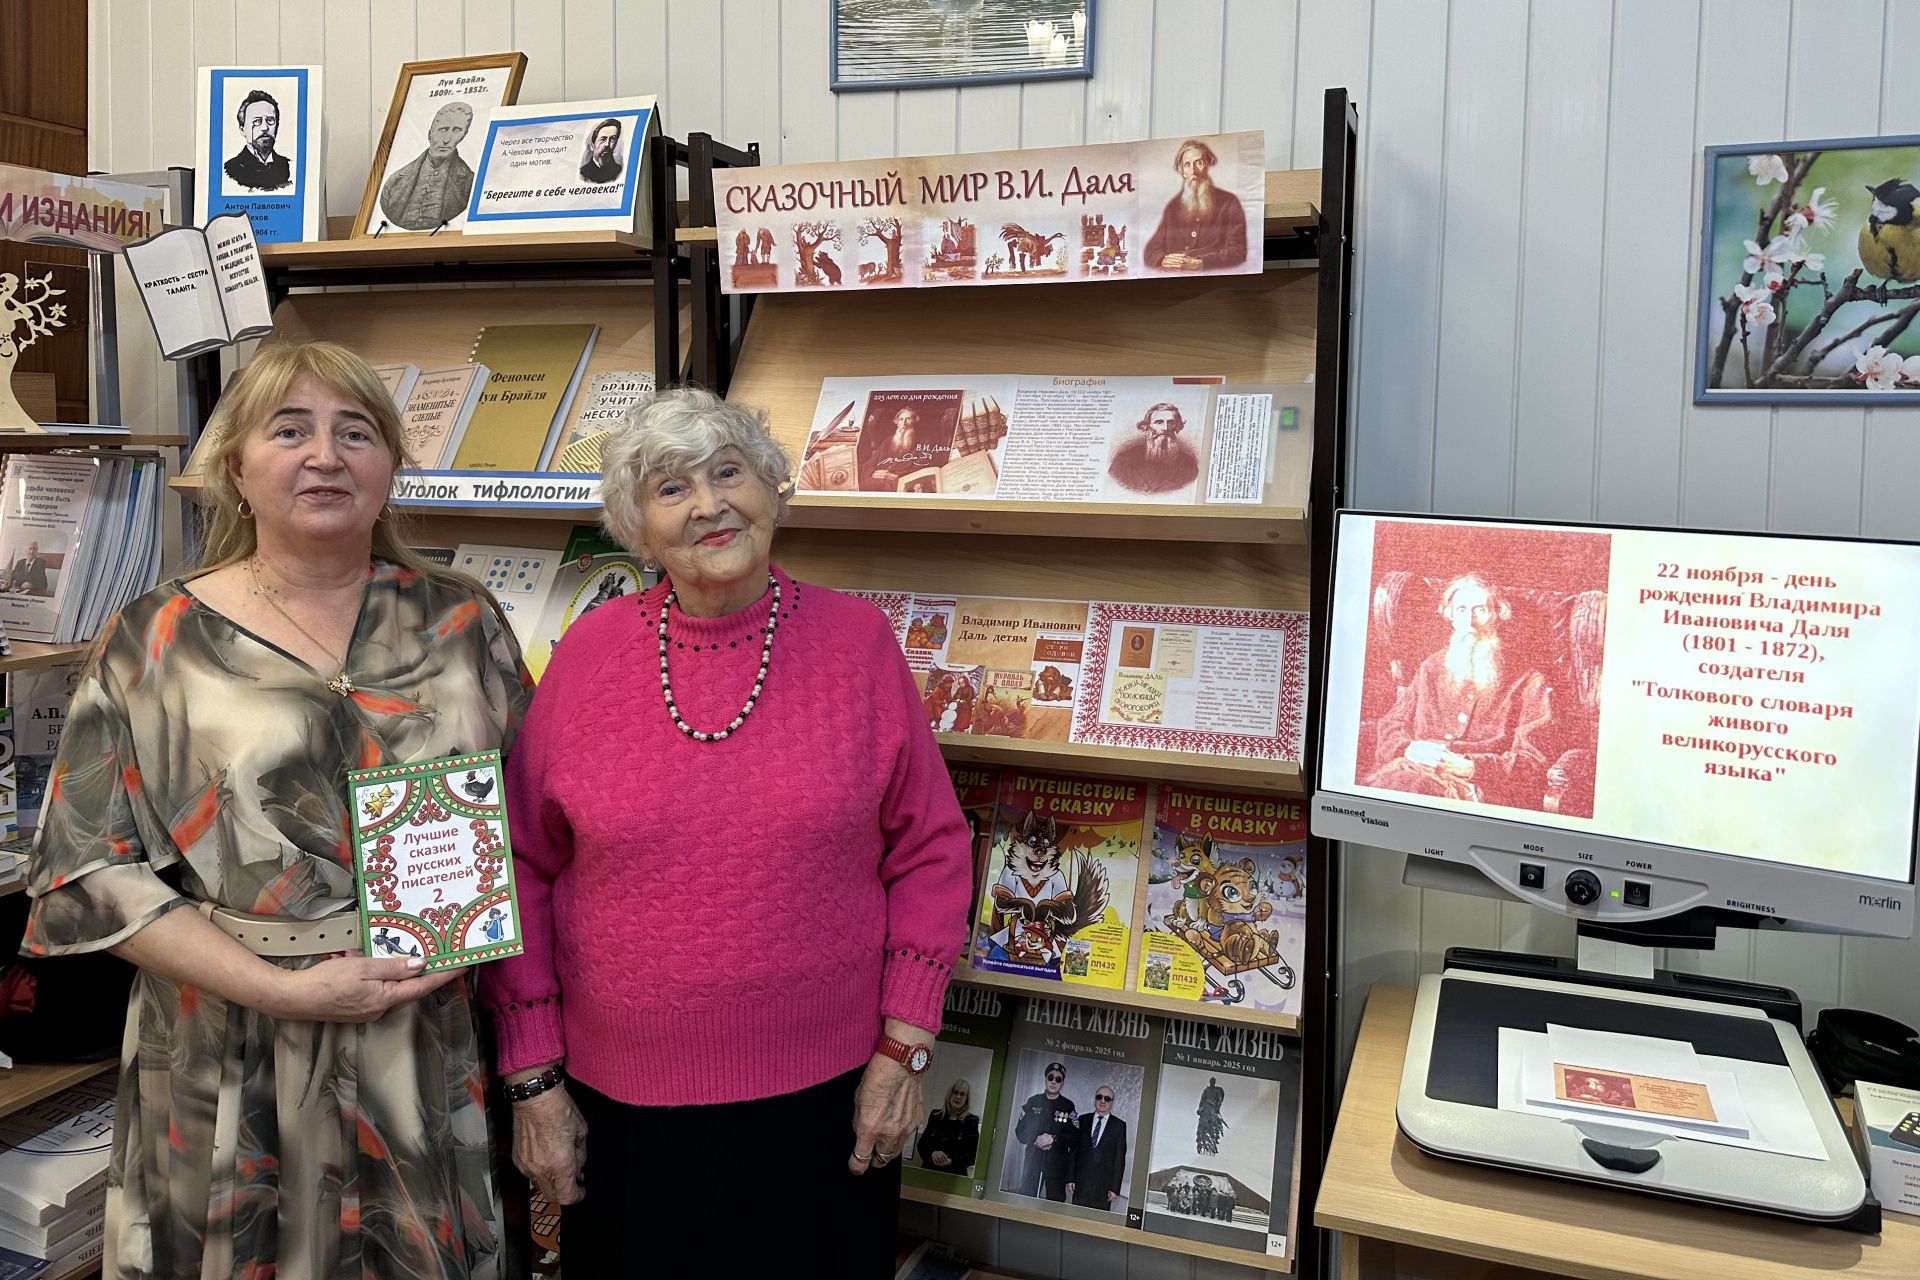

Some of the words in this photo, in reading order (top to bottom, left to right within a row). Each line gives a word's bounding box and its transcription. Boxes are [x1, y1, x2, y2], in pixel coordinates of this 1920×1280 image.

[438, 78, 453, 87] Луи
[455, 75, 486, 85] Брайль
[429, 88, 454, 98] 1809г.
[463, 86, 488, 95] 1852г.
[500, 137, 520, 147] Через
[521, 137, 533, 145] все
[534, 134, 573, 144] творчество
[533, 146, 567, 156] проходит
[509, 160, 527, 168] один
[483, 189, 534, 201] "Берегите
[543, 186, 565, 197] себе
[568, 183, 625, 196] человека!"
[725, 170, 907, 214] СКАЗОЧНЫЙ
[919, 171, 988, 205] МИР
[994, 168, 1053, 200] В.И.
[1061, 166, 1135, 206] Даля
[251, 202, 291, 210] Павлович
[22, 194, 150, 238] ИЗДАНИЯ!
[144, 276, 180, 289] КРАТКОСТЬ
[187, 269, 209, 280] СЕСТРА
[166, 283, 197, 296] ТАЛАНТА.
[490, 372, 546, 384] Феномен
[1052, 377, 1106, 387] Биография
[600, 381, 653, 393] БРАЙЛЬ
[501, 389, 547, 404] Брайля
[600, 396, 641, 406] УЧИТ
[873, 394, 885, 402] 225
[922, 394, 958, 402] рождения
[406, 399, 457, 412] ЗНАМЕНИТЫЕ
[411, 411, 443, 423] СЛЕПЫЕ
[583, 409, 625, 420] НЕСКУ
[931, 444, 951, 453] Даль
[25, 485, 44, 493] удьба
[45, 486, 75, 494] человека
[398, 481, 459, 499] Уголок
[473, 480, 591, 501] тифлологии
[1657, 562, 1680, 578] 22
[1686, 565, 1764, 587] ноября
[1784, 573, 1837, 589] день
[1639, 588, 1742, 606] рождения
[1749, 591, 1882, 620] Владимира
[961, 615, 1020, 630] Владимир
[1022, 618, 1082, 631] Иванович
[1662, 608, 1784, 633] Ивановича
[1790, 618, 1850, 639] Даля
[958, 630, 987, 642] Даль
[993, 632, 1028, 644] детям
[1682, 633, 1736, 653] (1801
[1760, 639, 1825, 663] 1872),
[1118, 672, 1143, 680] Владимир
[1698, 661, 1805, 684] создателя
[1631, 679, 1753, 707] "Толкового
[1760, 696, 1854, 720] словаря
[1707, 713, 1789, 735] живого
[1661, 732, 1837, 766] великорусского
[1704, 761, 1786, 782] языка"
[1016, 776, 1136, 802] ПУТЕШЕСТВИЕ
[1033, 796, 1044, 811] В
[1049, 798, 1116, 817] СКАЗКУ
[1170, 792, 1301, 821] ПУТЕШЕСТВИЕ
[1320, 804, 1366, 818] enhanced
[1190, 813, 1201, 828] В
[1207, 815, 1278, 836] СКАЗКУ
[1361, 816, 1390, 828] vision
[403, 827, 459, 846] Лучшие
[409, 842, 456, 859] сказки
[1424, 847, 1444, 856] LIGHT
[1523, 843, 1545, 853] MODE
[1577, 852, 1594, 861] SIZE
[407, 855, 462, 876] русских
[1625, 860, 1653, 870] POWER
[401, 866, 474, 890] писателей
[433, 888, 444, 903] 2
[1726, 899, 1776, 914] BRIGHTNESS
[1090, 960, 1116, 970] ПП432
[1172, 974, 1198, 984] ПП432
[1025, 997, 1083, 1030] НАША
[1086, 1005, 1150, 1039] ЖИЗНЬ
[958, 1025, 970, 1035] год
[1164, 1017, 1211, 1051] АША
[1214, 1024, 1284, 1061] ЖИЗНЬ
[1061, 1041, 1093, 1054] февраль
[1094, 1046, 1111, 1056] 2025
[1112, 1049, 1125, 1058] год
[1192, 1056, 1221, 1067] январь
[1222, 1061, 1241, 1070] 2025
[1242, 1065, 1256, 1073] год
[1129, 1213, 1141, 1222] 12+
[1270, 1240, 1282, 1248] 12+
